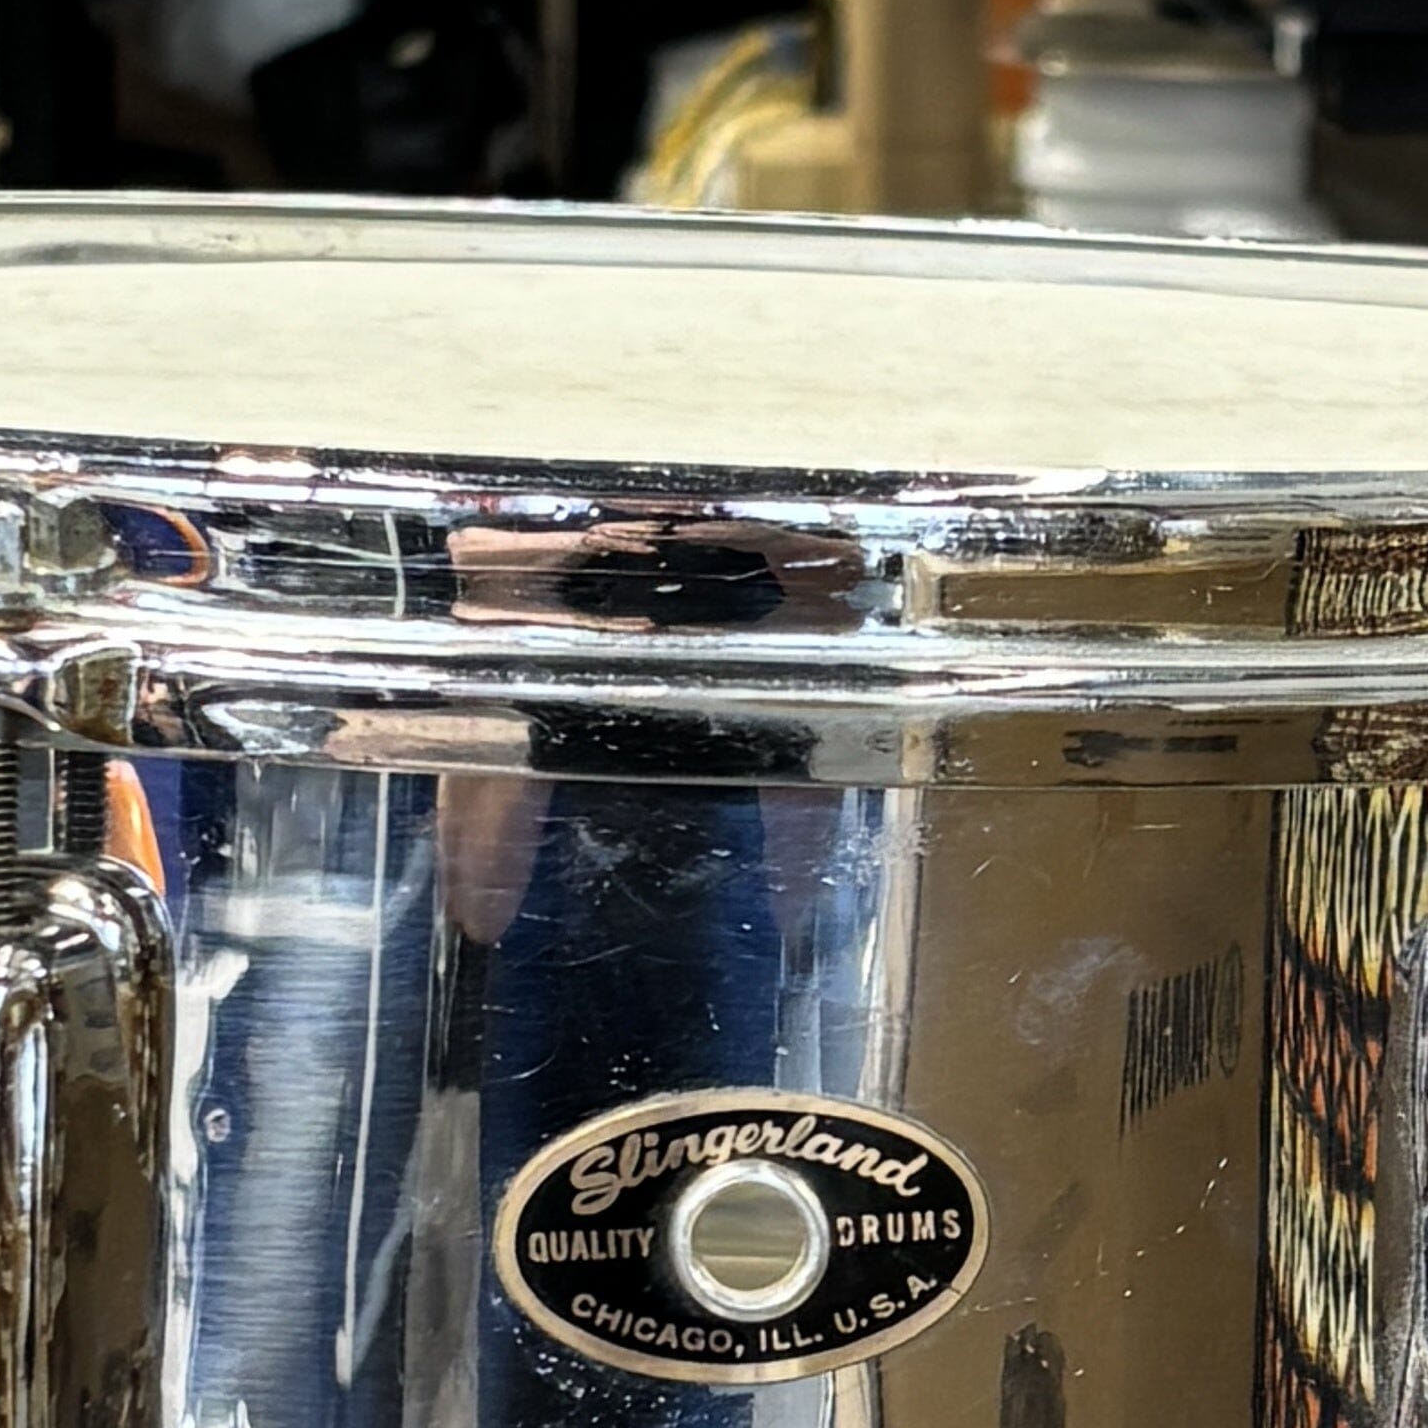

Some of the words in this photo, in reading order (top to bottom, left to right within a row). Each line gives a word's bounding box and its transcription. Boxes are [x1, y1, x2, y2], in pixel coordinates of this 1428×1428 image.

[569, 1115, 928, 1215] Slingerland
[527, 1227, 655, 1264] QUALITY
[835, 1208, 961, 1246] DRUMS
[571, 1291, 745, 1358] CHICAGO,
[758, 1326, 824, 1352] ILL.
